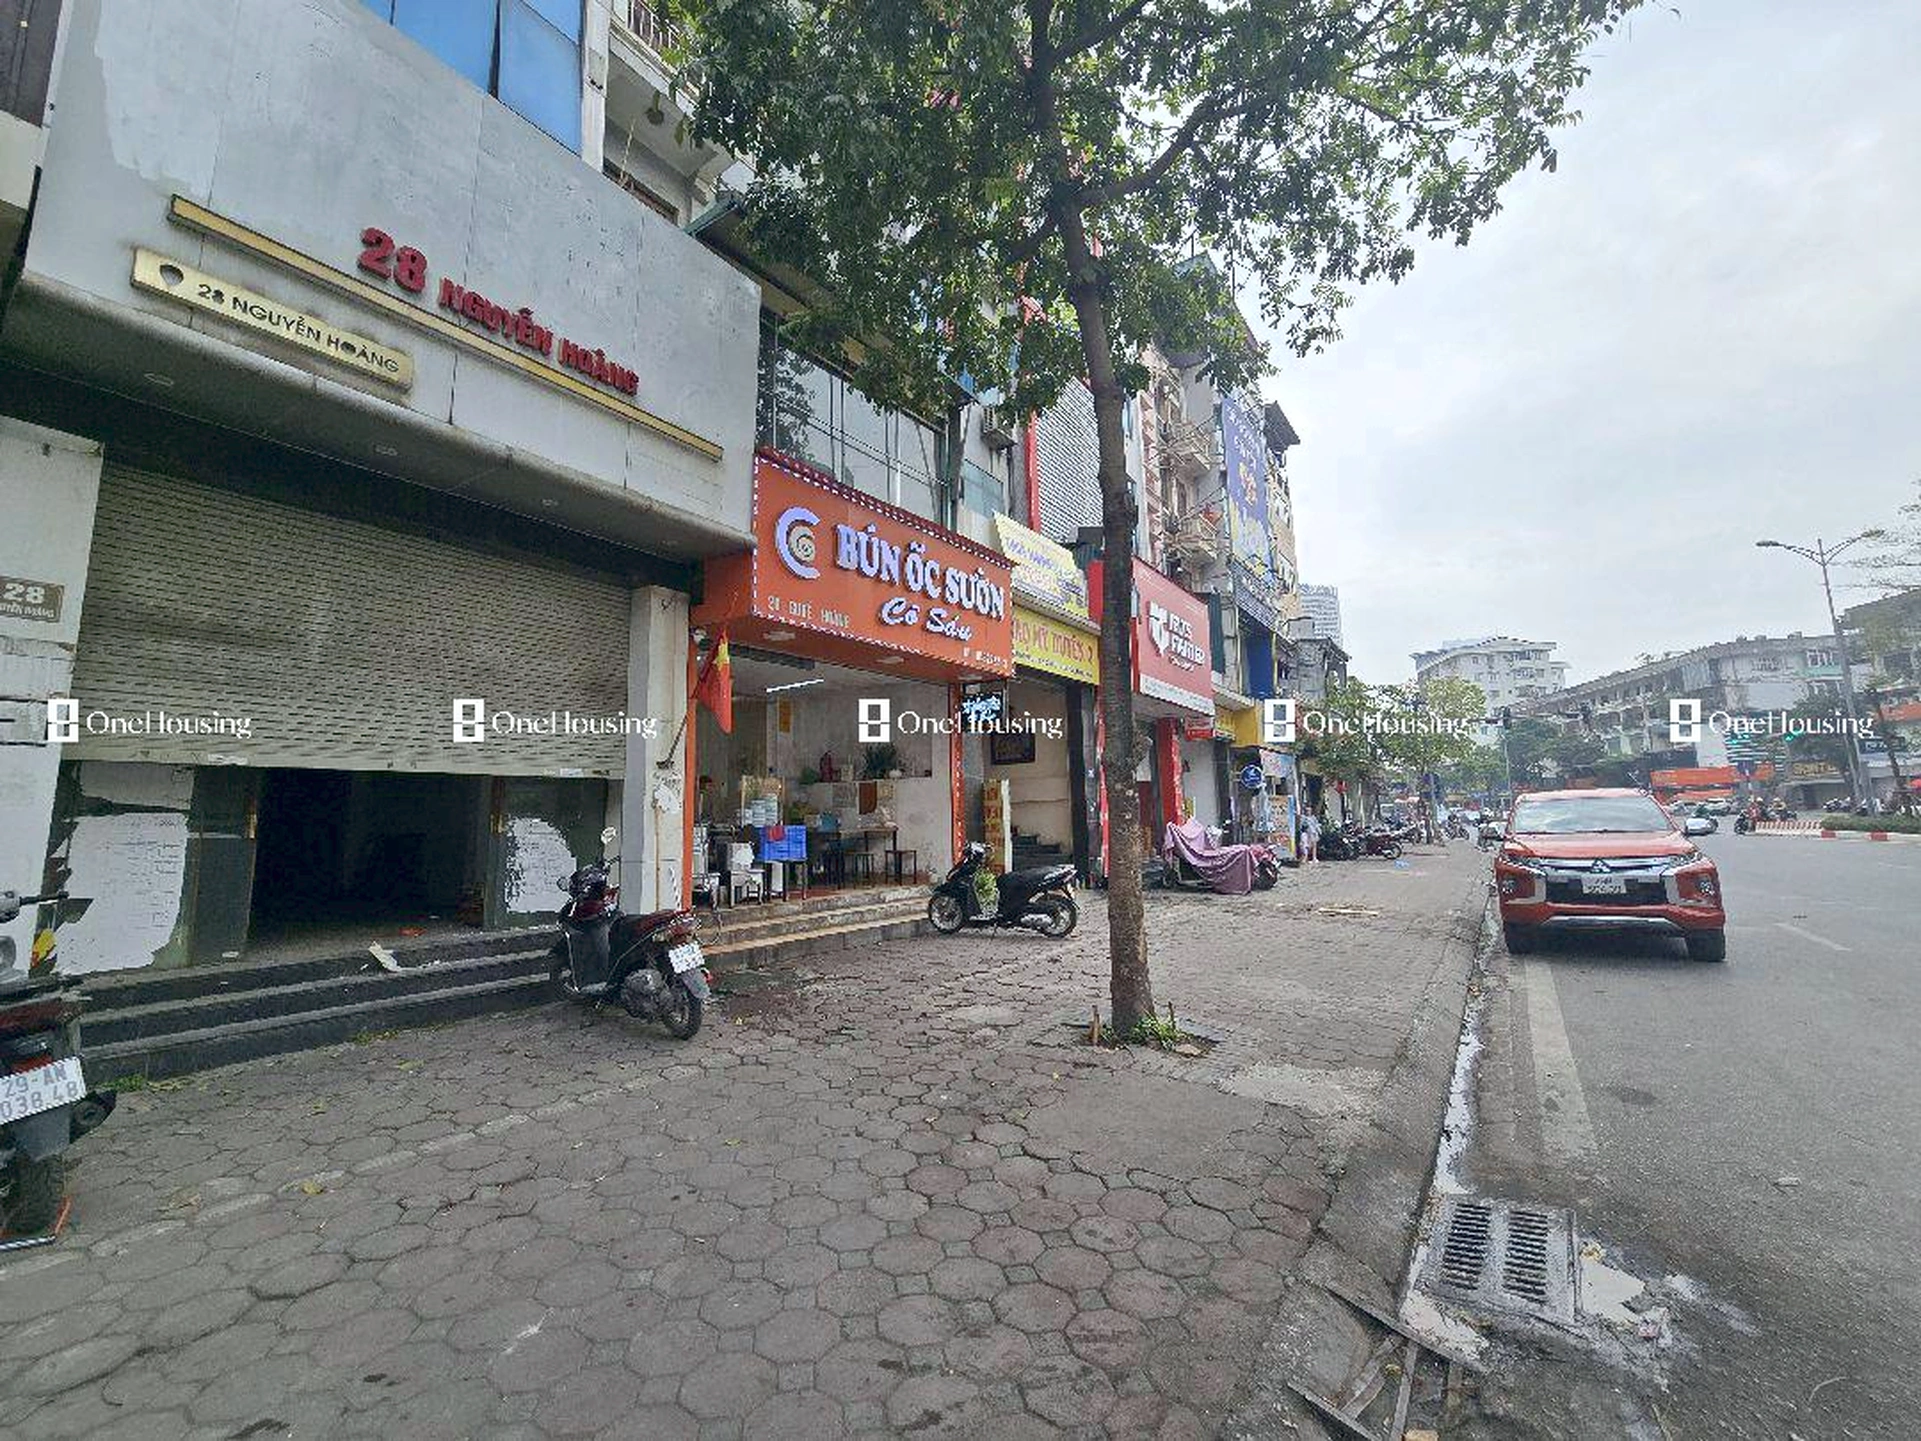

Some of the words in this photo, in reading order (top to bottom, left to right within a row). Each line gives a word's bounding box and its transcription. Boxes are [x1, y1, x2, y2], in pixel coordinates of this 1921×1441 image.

[356, 227, 428, 293] 28
[197, 283, 225, 305] 28
[3, 582, 45, 604] 28
[834, 523, 901, 585] BÚN
[904, 541, 941, 599] ỐC
[944, 567, 1005, 621] SƯỜN
[878, 596, 921, 626] Cô
[925, 607, 973, 642] Sáu
